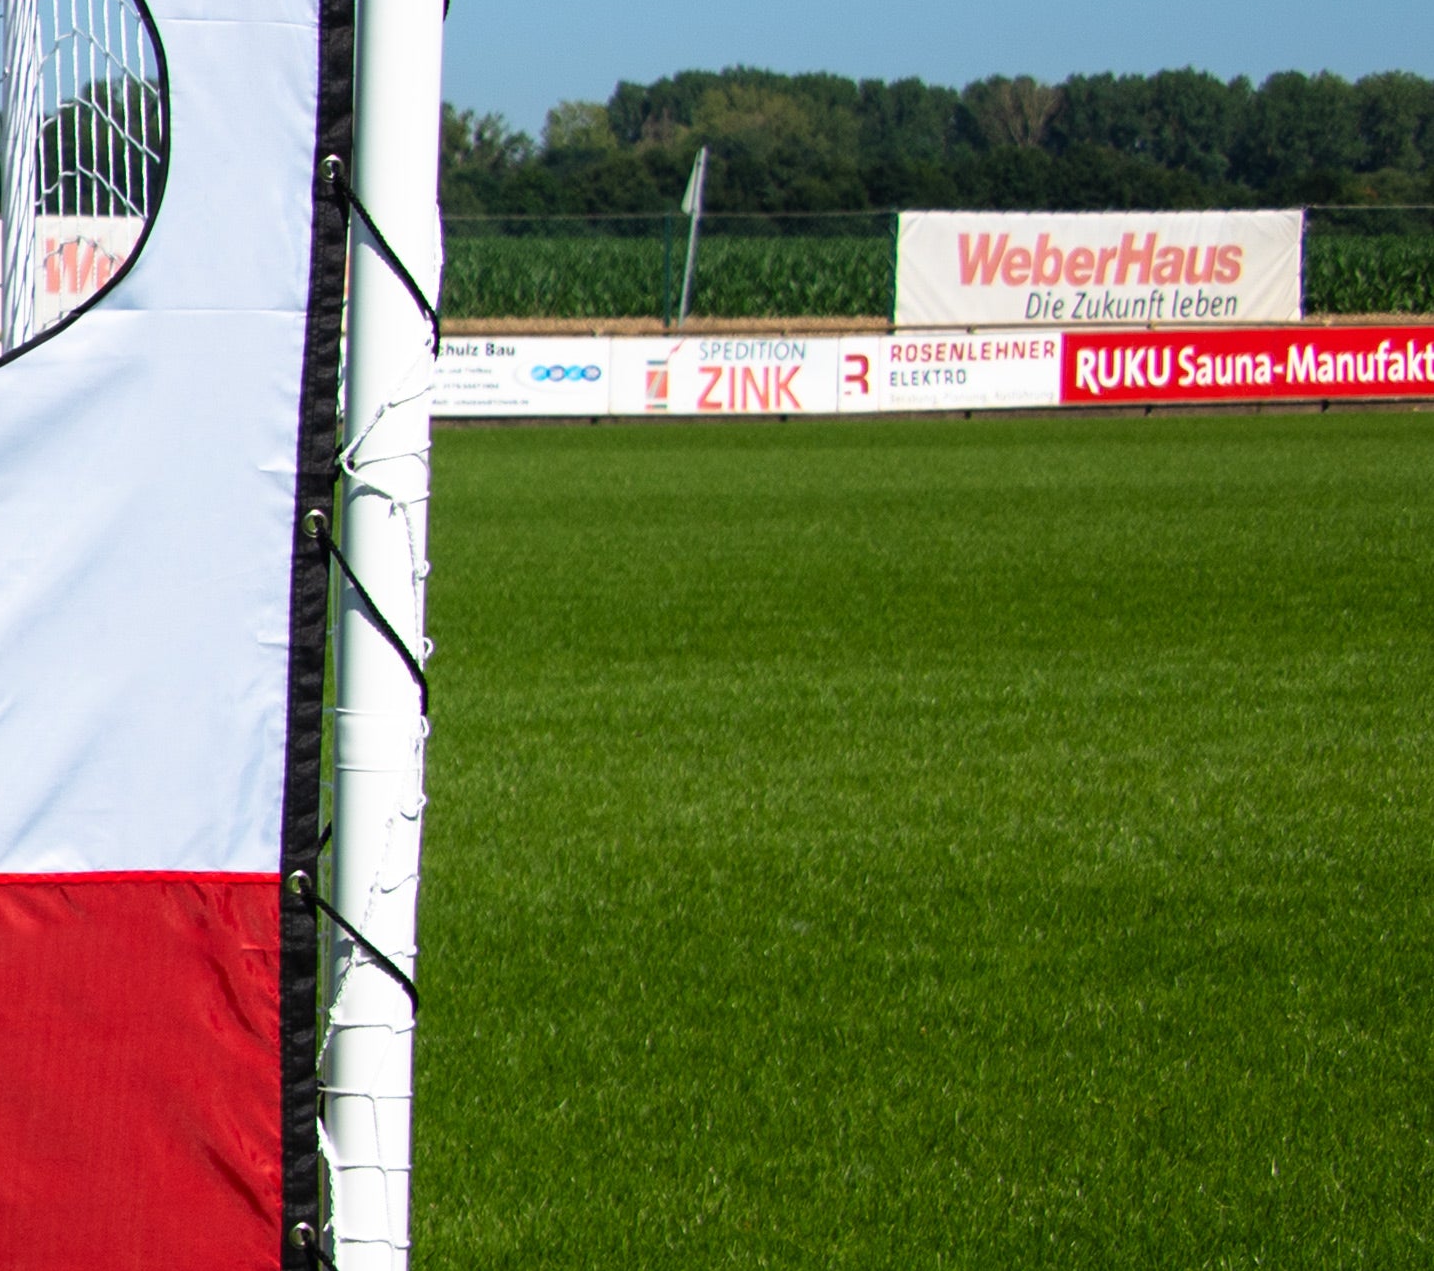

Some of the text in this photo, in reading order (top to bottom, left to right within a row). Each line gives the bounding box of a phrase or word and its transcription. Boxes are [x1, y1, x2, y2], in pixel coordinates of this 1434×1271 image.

[958, 232, 1243, 287] WeberHaus
[1025, 289, 1238, 321] Die Zukunft leben
[699, 341, 807, 361] SPEDITION
[889, 340, 1056, 363] ROSENLEHNER
[1076, 338, 1434, 395] RUKU Sauna-Manufakt
[697, 366, 802, 410] ZINK
[889, 369, 967, 387] ELEKTRO
